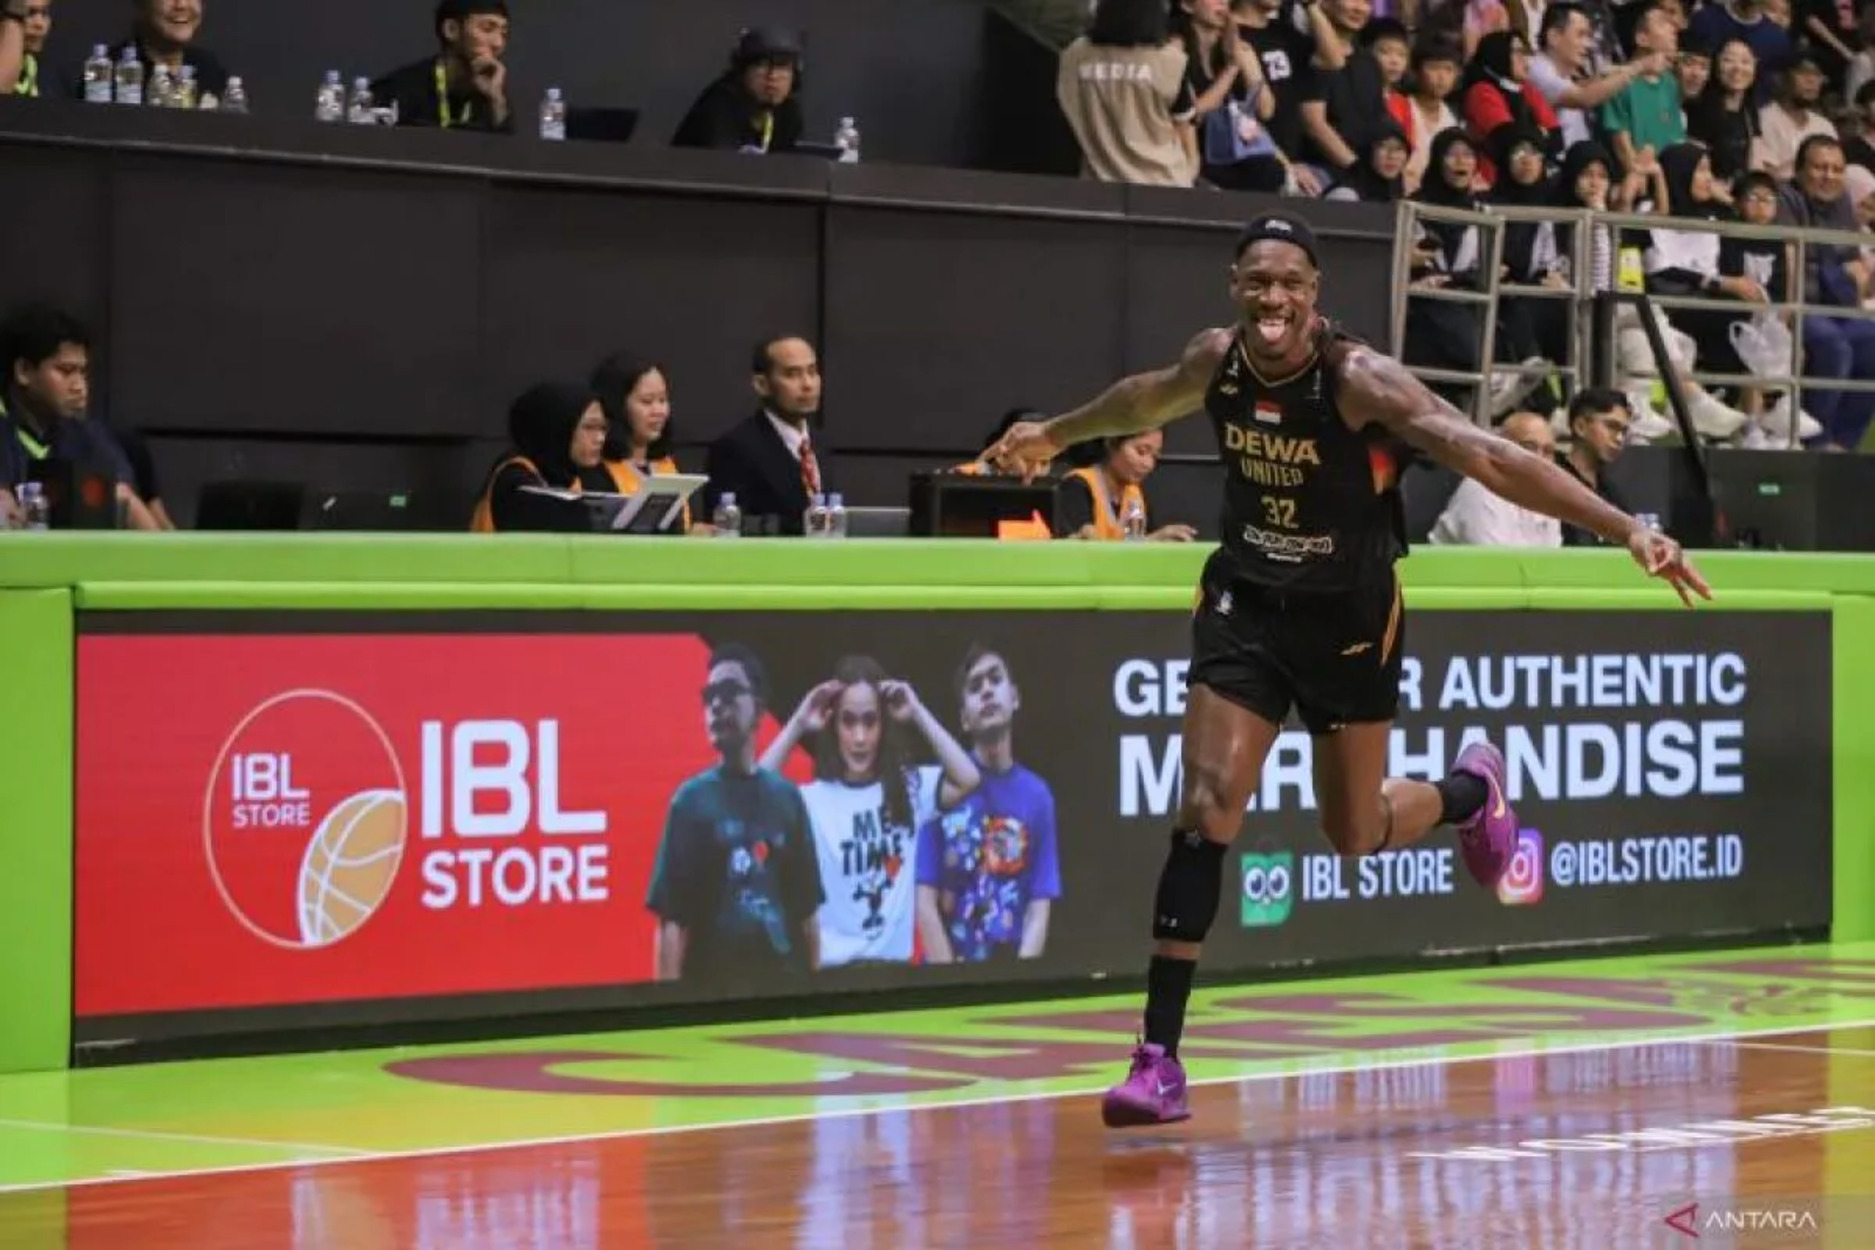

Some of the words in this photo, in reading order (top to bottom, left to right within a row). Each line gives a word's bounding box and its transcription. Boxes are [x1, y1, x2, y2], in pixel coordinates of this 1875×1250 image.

[1225, 423, 1320, 465] DEWA
[1241, 457, 1304, 486] UNITED
[1261, 496, 1299, 529] 32
[1113, 659, 1191, 717] GE
[1438, 653, 1746, 710] AUTHENTIC
[231, 752, 310, 802] IBL
[421, 719, 608, 839] IBL
[1119, 720, 1744, 816] MRHNDISE
[232, 802, 311, 829] STORE
[421, 845, 610, 909] STORE
[1302, 854, 1351, 901] IBL
[1358, 848, 1454, 897] STORE
[1550, 834, 1743, 886] @IBLSTORE.ID
